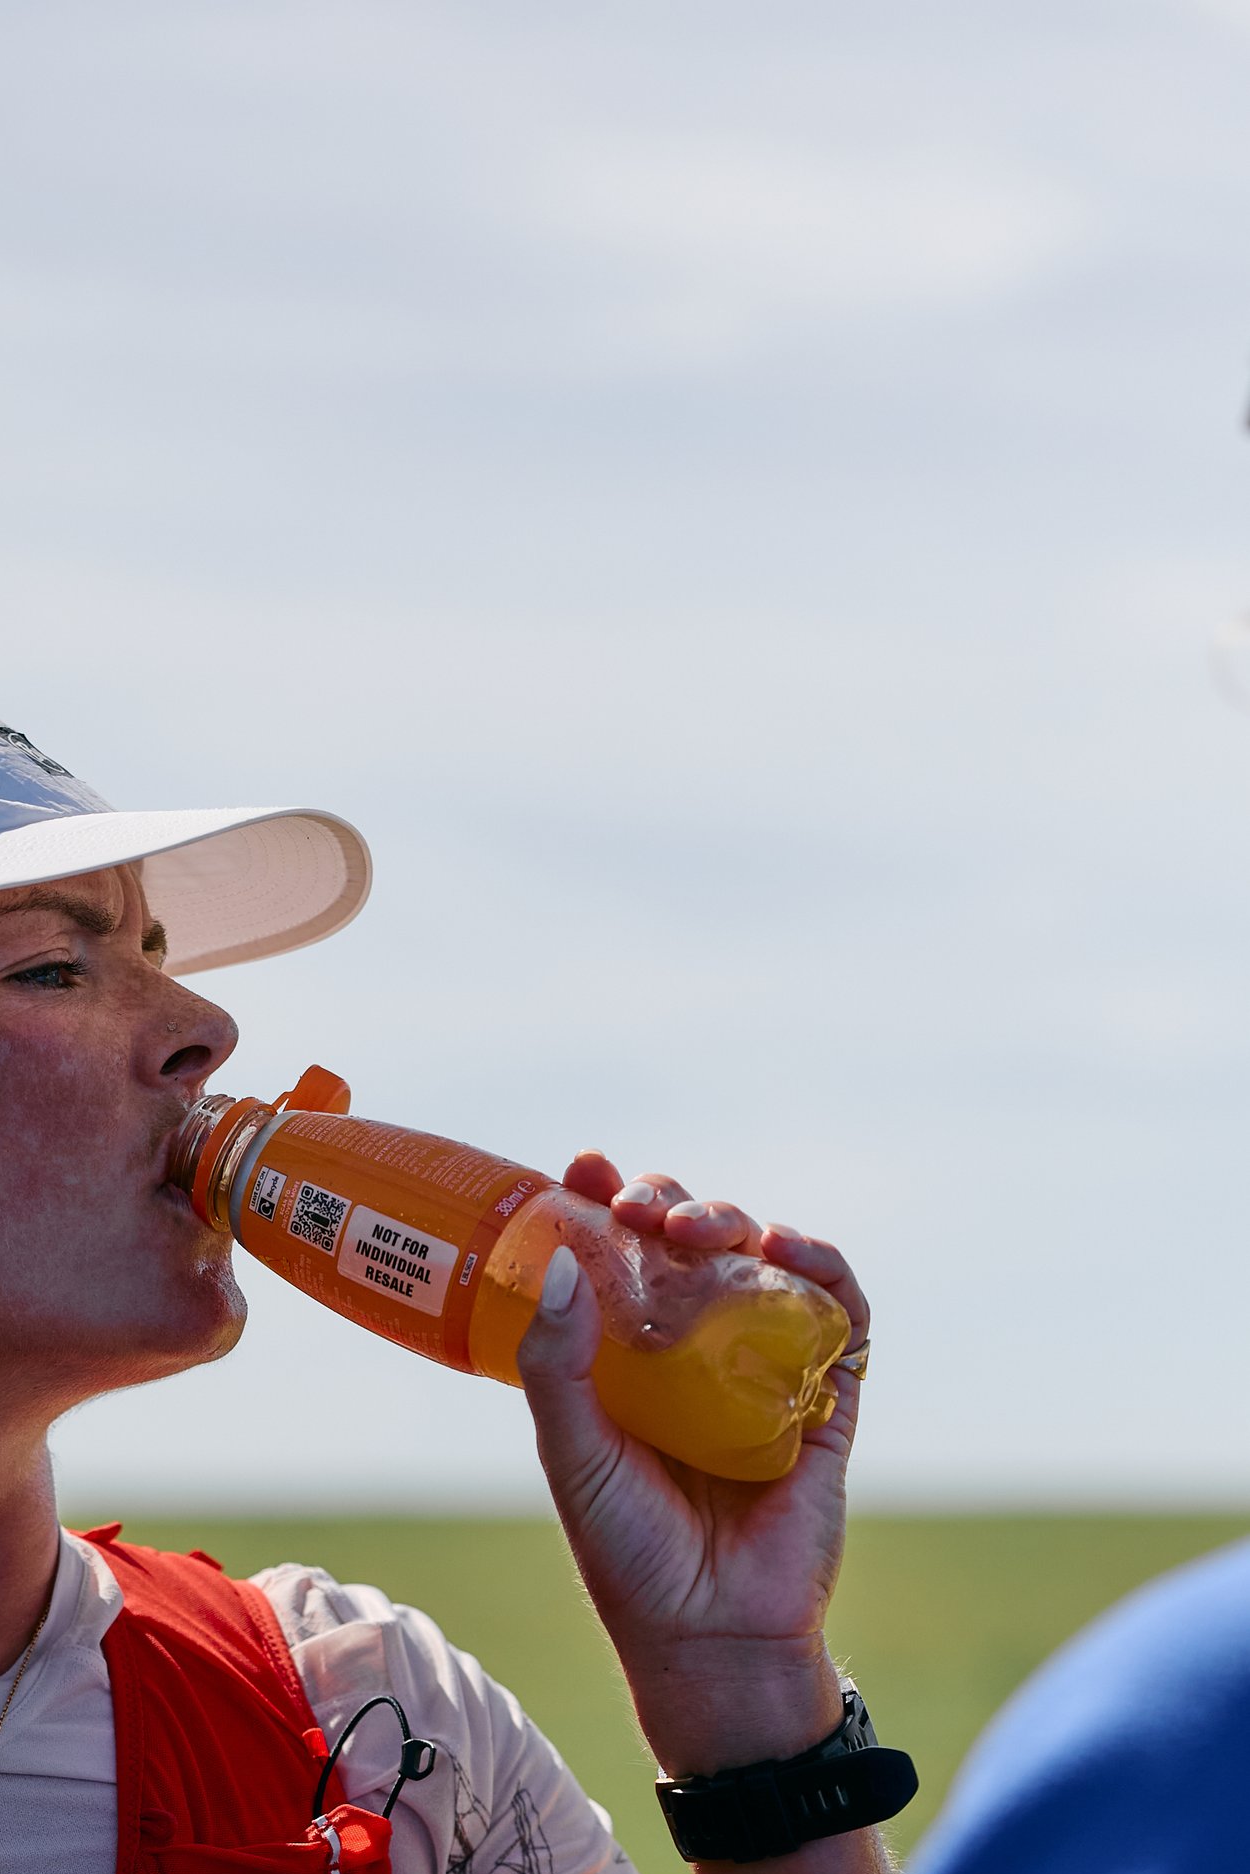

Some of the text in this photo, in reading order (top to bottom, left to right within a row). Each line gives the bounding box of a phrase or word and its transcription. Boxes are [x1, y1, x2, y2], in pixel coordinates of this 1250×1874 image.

[267, 1176, 279, 1198] Recycle
[280, 1189, 291, 1216] SCAN TO
[494, 1189, 525, 1217] 380ml
[281, 1181, 300, 1229] DISCOVER MORE
[372, 1224, 429, 1260] NOT FOR
[355, 1239, 431, 1284] INDIVIDUAL
[365, 1265, 414, 1298] RESALE
